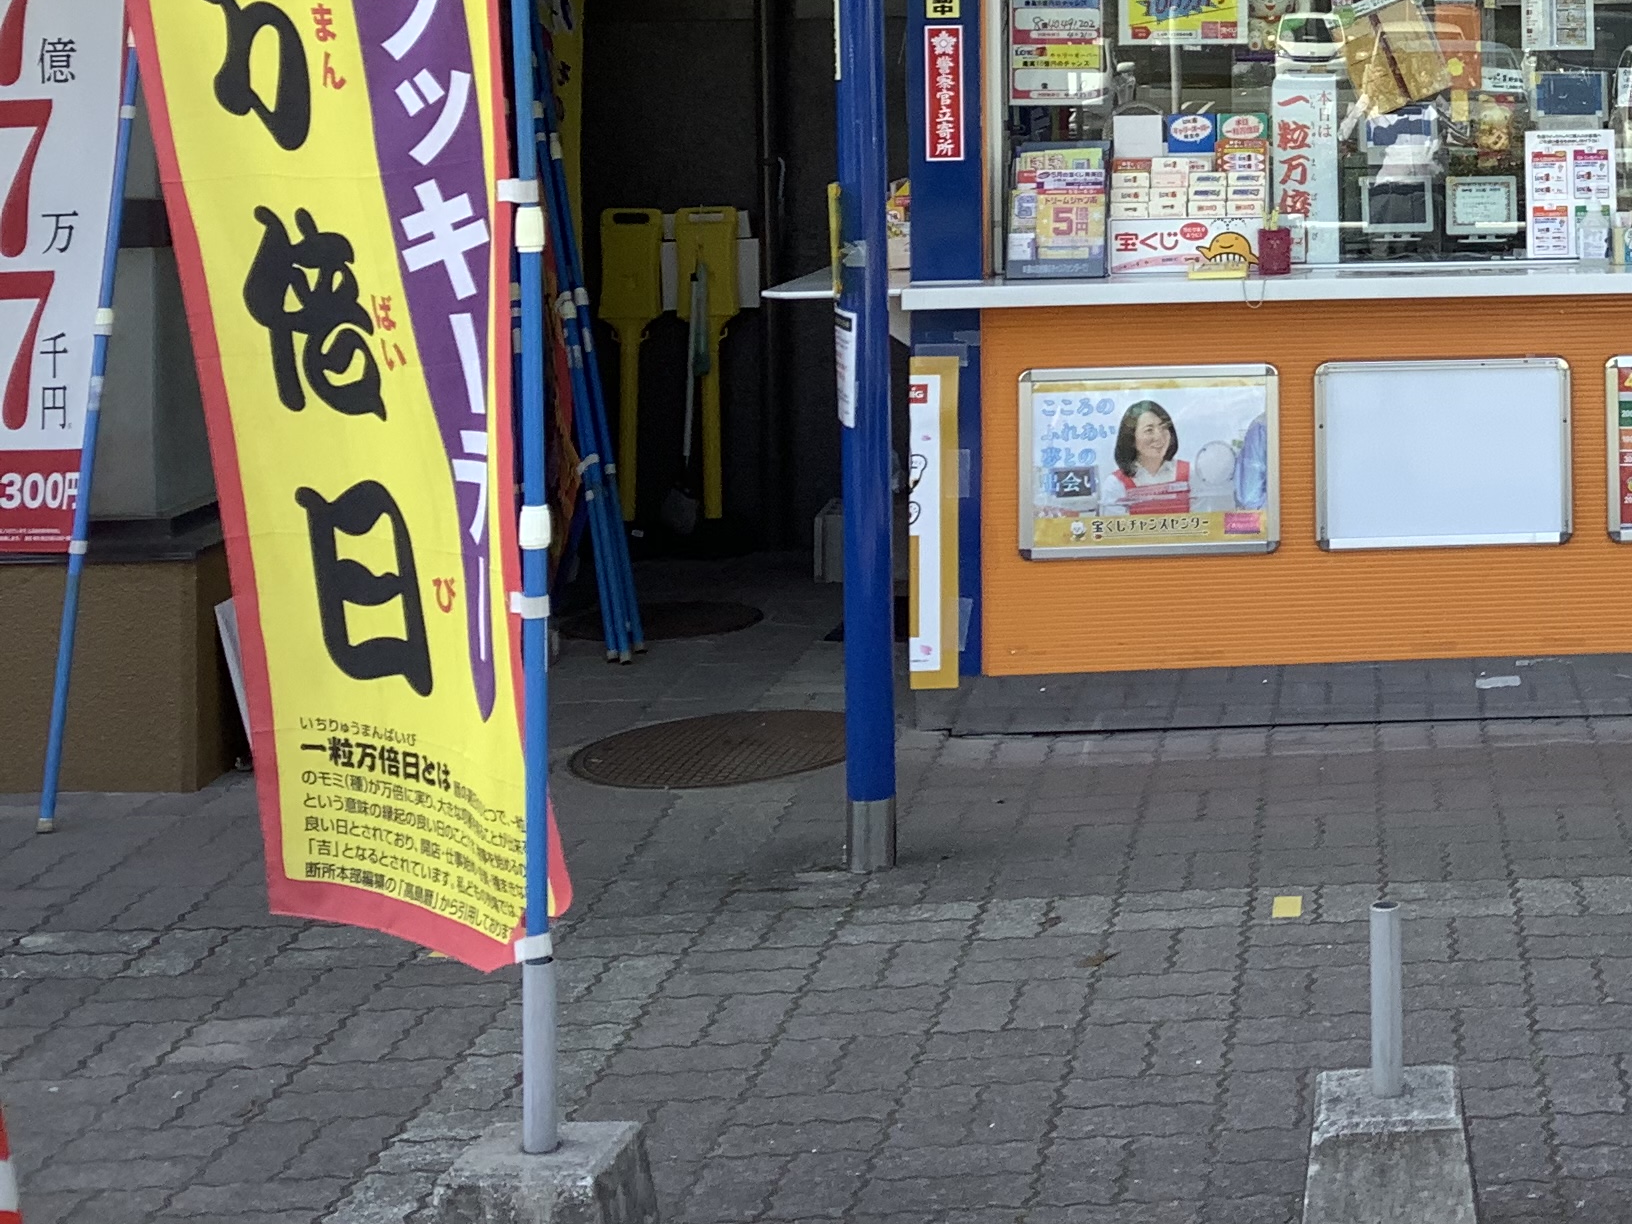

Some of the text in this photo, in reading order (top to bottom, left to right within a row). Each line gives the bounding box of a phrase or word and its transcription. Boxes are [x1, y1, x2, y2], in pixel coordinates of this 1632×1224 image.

[311, 4, 346, 90] まん
[1317, 90, 1333, 138] 本日は
[1115, 231, 1179, 252] 宝くじ
[370, 293, 407, 372] ばい
[300, 736, 451, 793] 一粒万倍日とは
